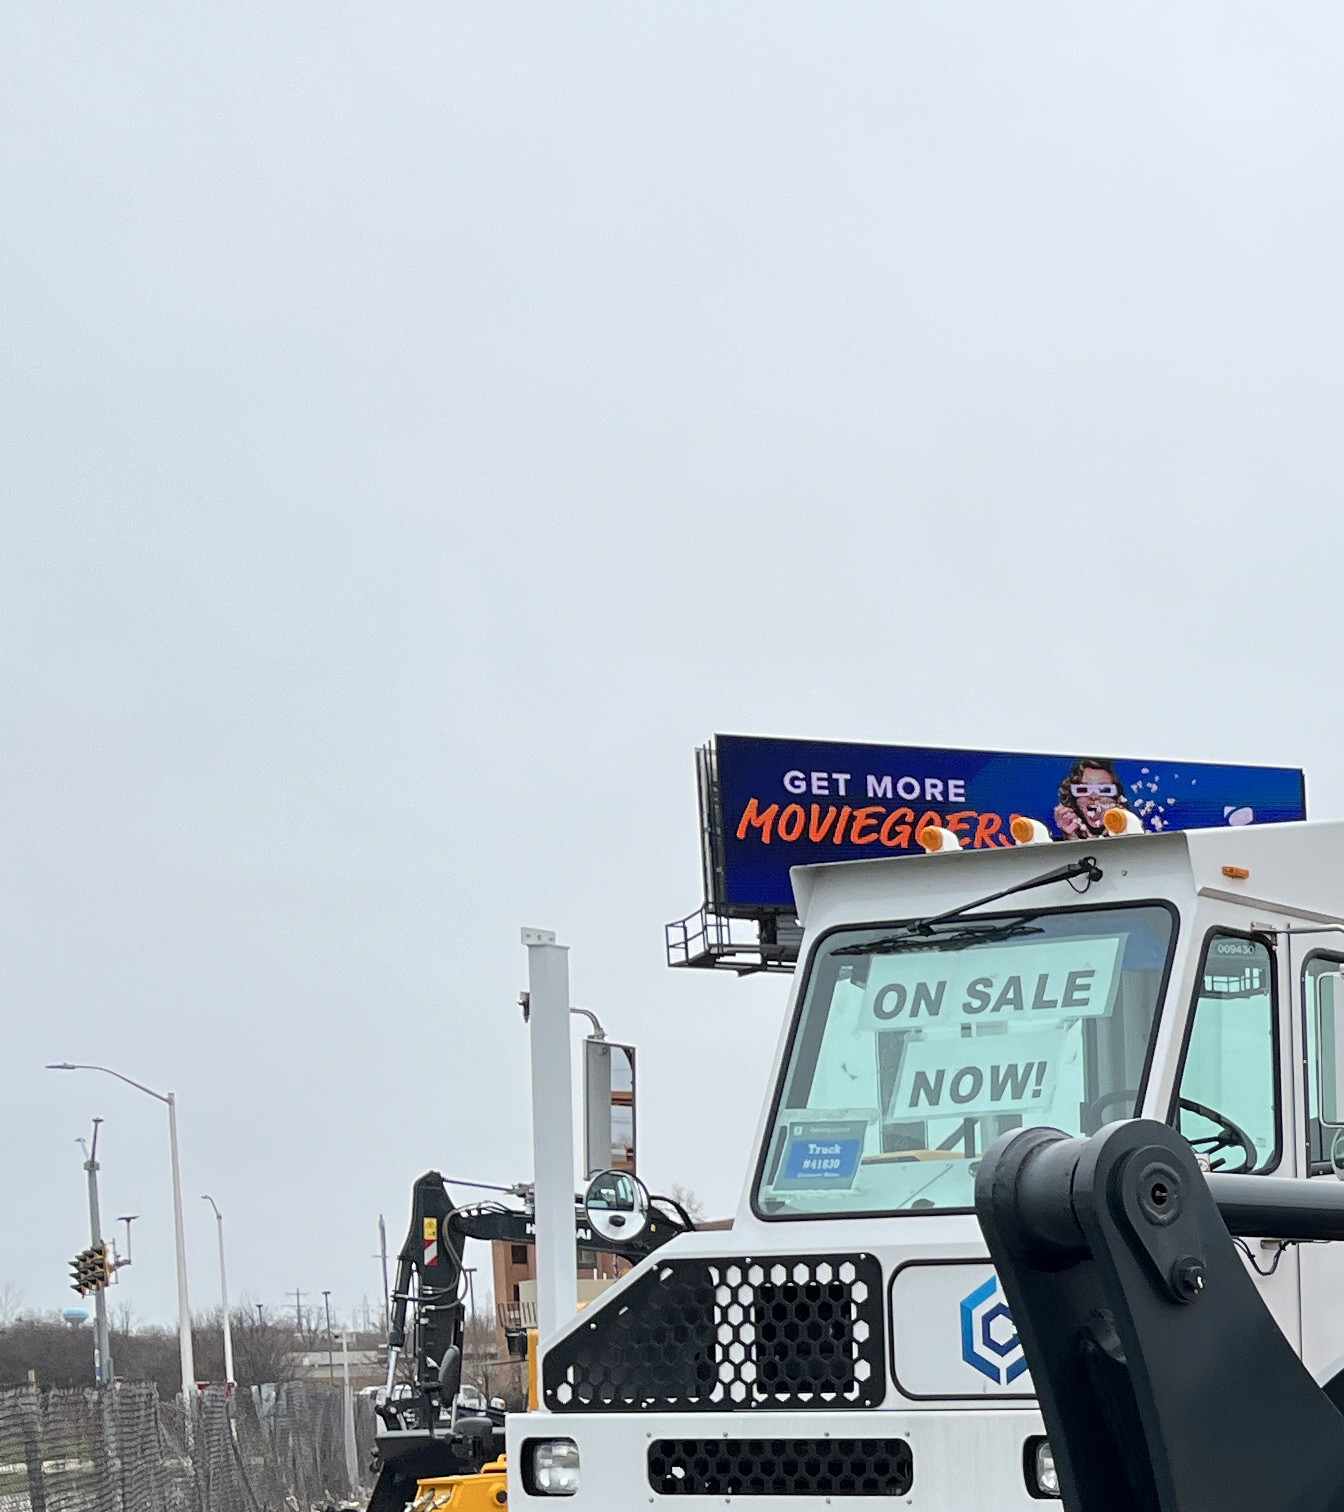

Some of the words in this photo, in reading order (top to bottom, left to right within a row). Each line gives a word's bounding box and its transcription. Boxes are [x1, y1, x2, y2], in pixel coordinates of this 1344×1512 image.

[783, 770, 851, 797] GET
[867, 775, 966, 802] MORE
[1217, 944, 1255, 955] 009430
[873, 980, 947, 1020] ON
[961, 969, 1096, 1015] SALE
[908, 1061, 1048, 1108] NOW!
[808, 1143, 841, 1155] Truck
